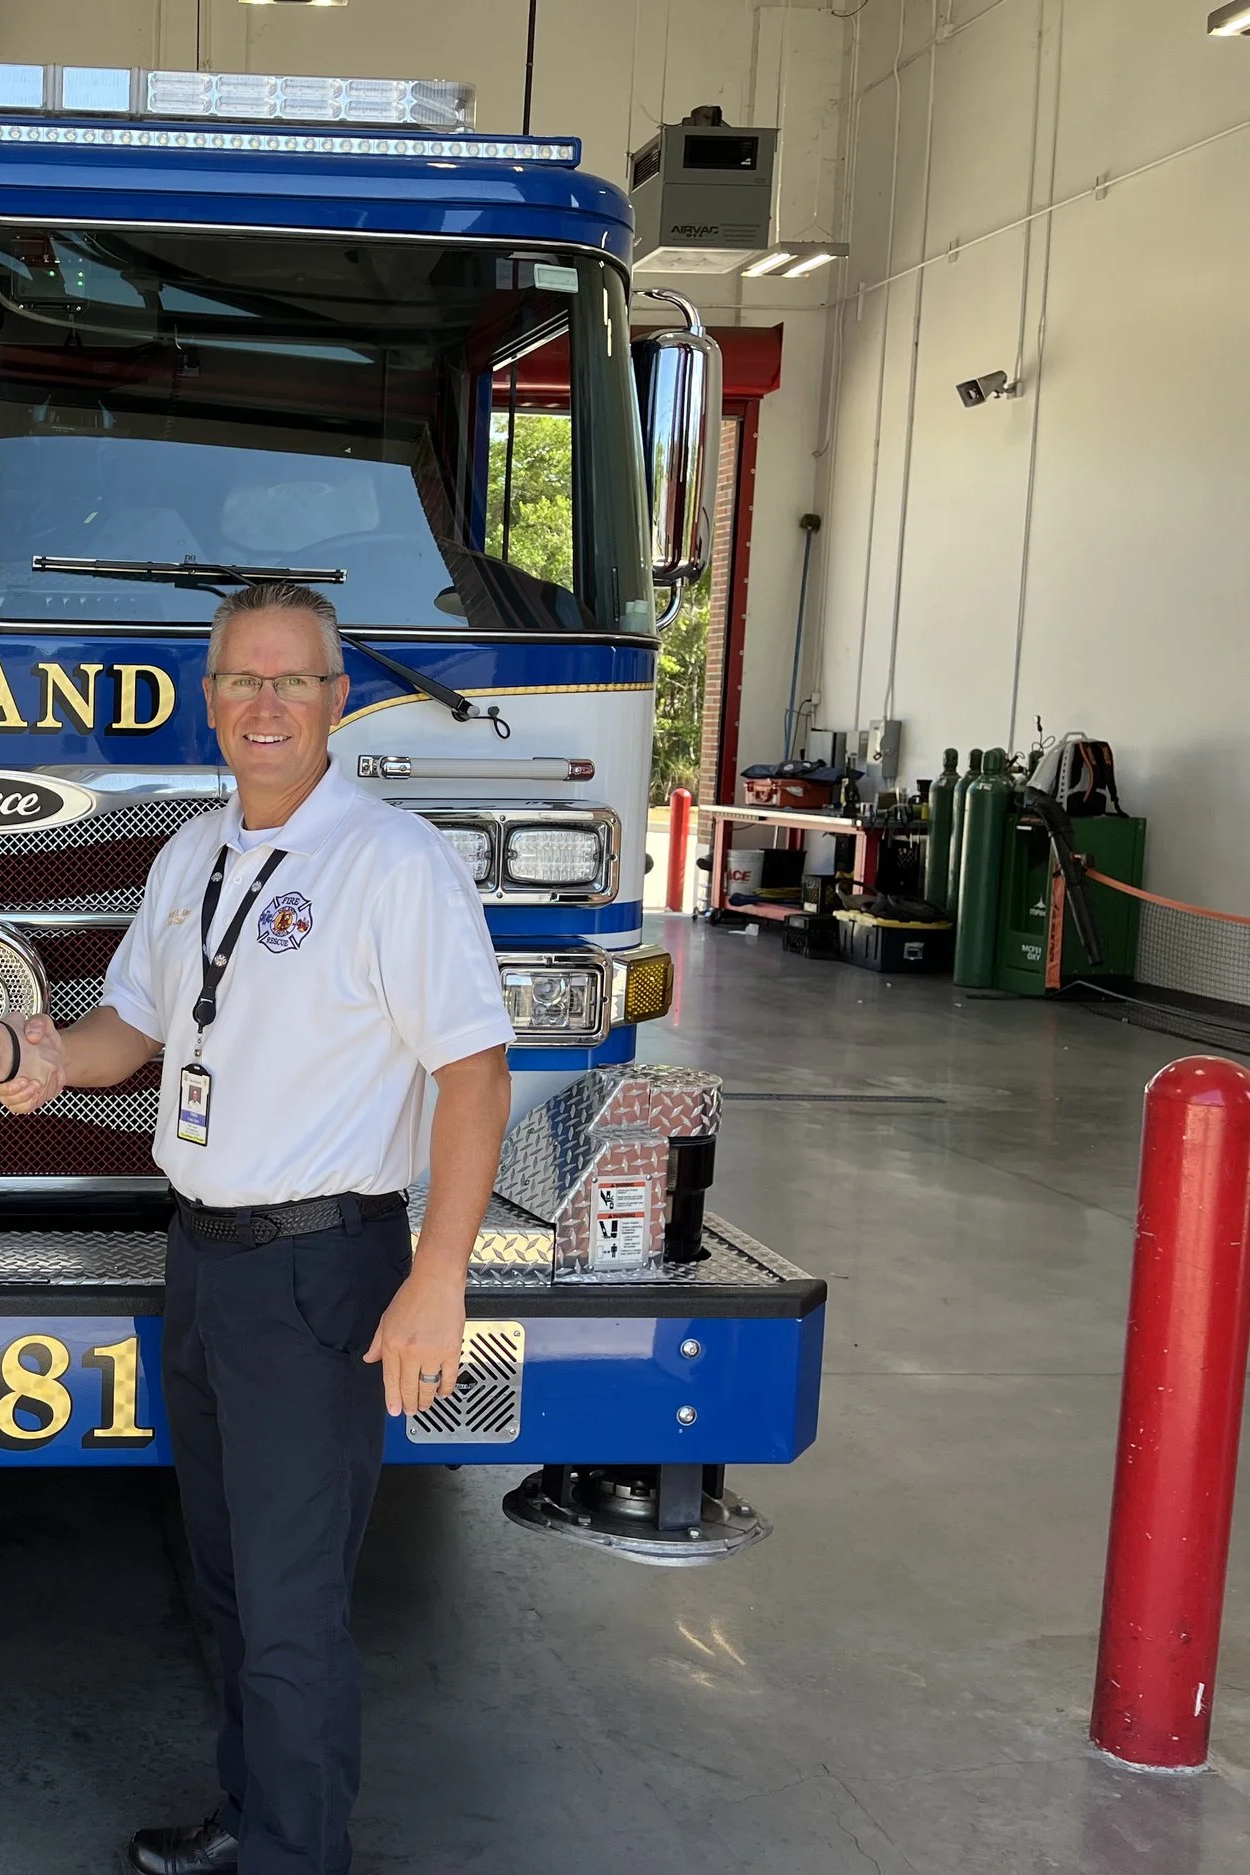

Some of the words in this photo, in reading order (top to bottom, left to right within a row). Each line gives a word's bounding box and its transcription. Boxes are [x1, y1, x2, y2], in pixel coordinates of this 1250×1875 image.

[670, 225, 719, 234] AIRVAC
[281, 896, 301, 906] FIRE
[265, 936, 289, 947] RESCUE
